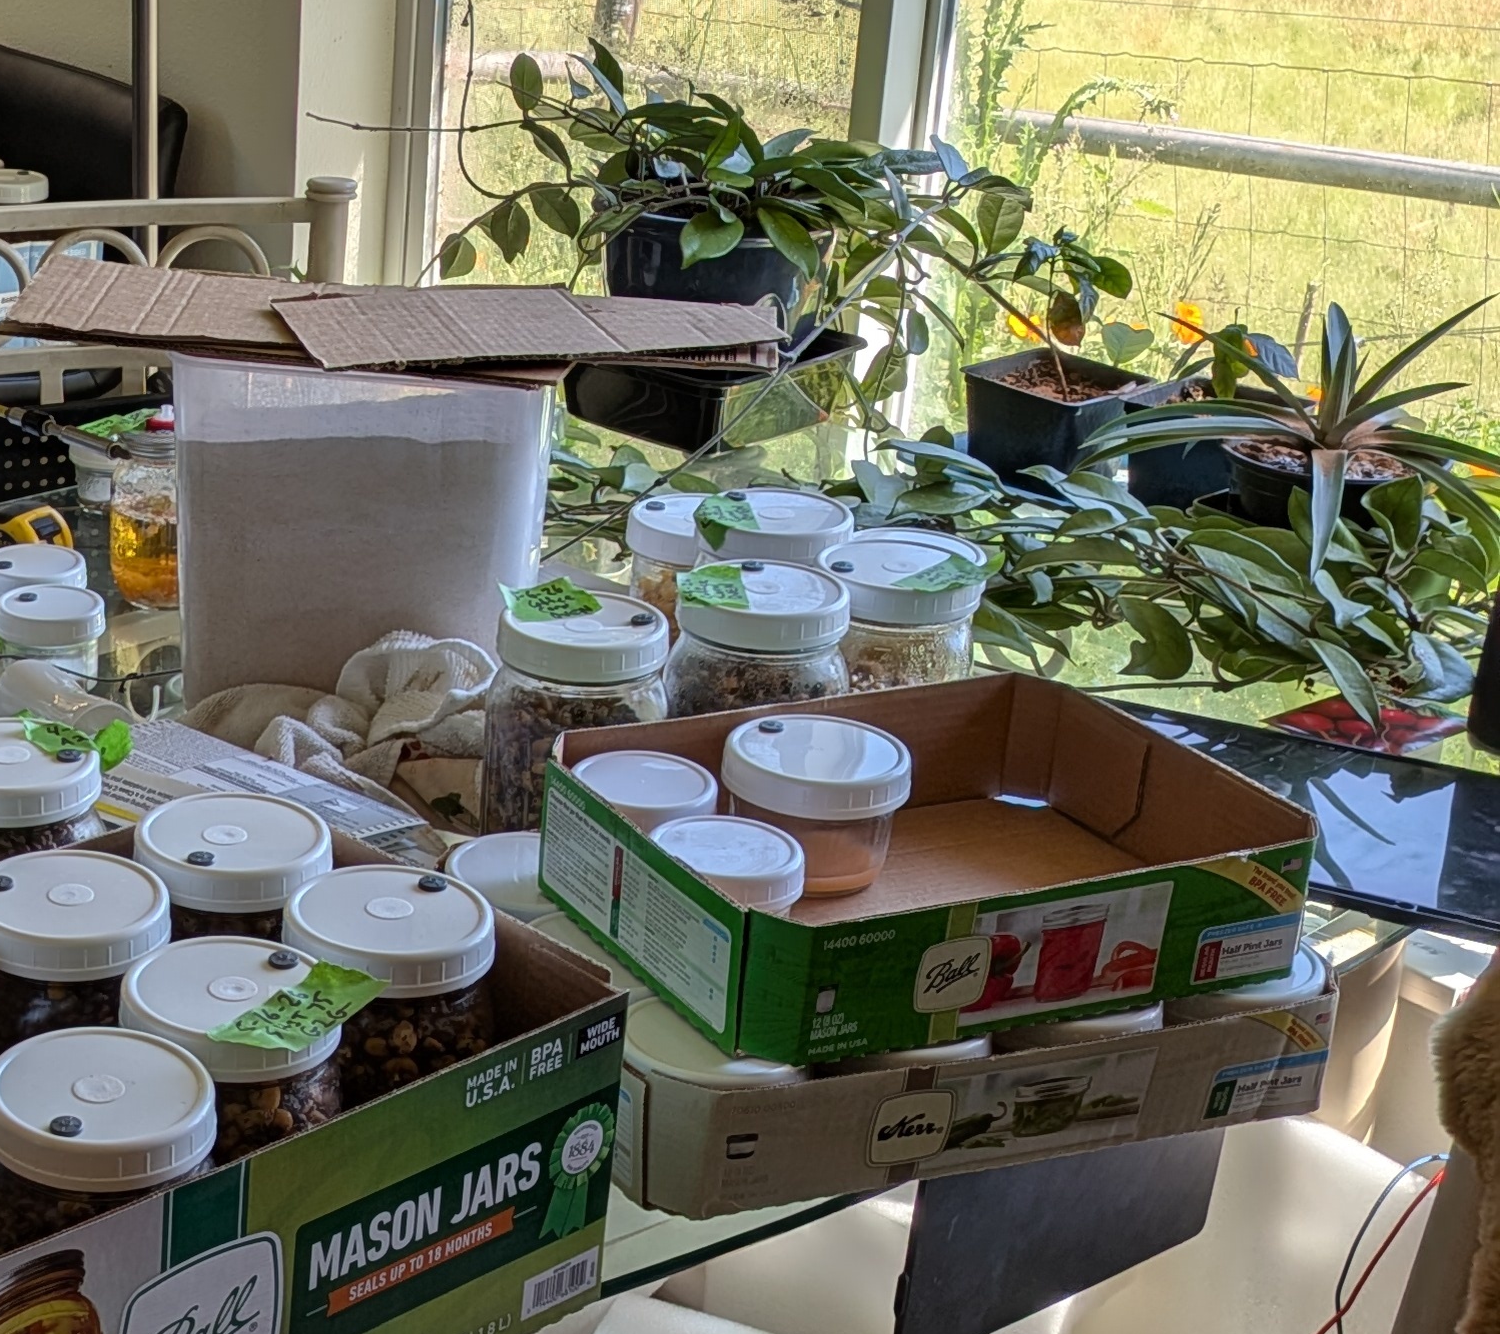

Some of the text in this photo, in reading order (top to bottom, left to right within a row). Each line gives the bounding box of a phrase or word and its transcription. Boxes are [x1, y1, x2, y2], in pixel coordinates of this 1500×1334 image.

[1248, 875, 1288, 907] BPA FREE
[823, 929, 896, 951] 14400 60000
[1222, 938, 1283, 955] Half Pint Jars
[923, 952, 981, 994] Ball
[579, 1026, 620, 1055] MOUTH
[586, 1016, 617, 1039] WIDE
[809, 1021, 858, 1042] MASON JARS
[530, 1037, 563, 1066] BPA
[807, 1038, 868, 1056] MADE IN USA
[466, 1057, 518, 1091] MADE IN
[528, 1054, 564, 1081] FREE
[465, 1075, 516, 1108] U.S.A.
[1238, 1081, 1259, 1093] Half
[877, 1113, 937, 1143] Kerr
[568, 1139, 595, 1158] 1884
[308, 1186, 443, 1291] MASON
[450, 1141, 543, 1225] JARS
[348, 1221, 493, 1302] SEALS UP TO 18 MONTHS
[498, 1312, 513, 1332] L)
